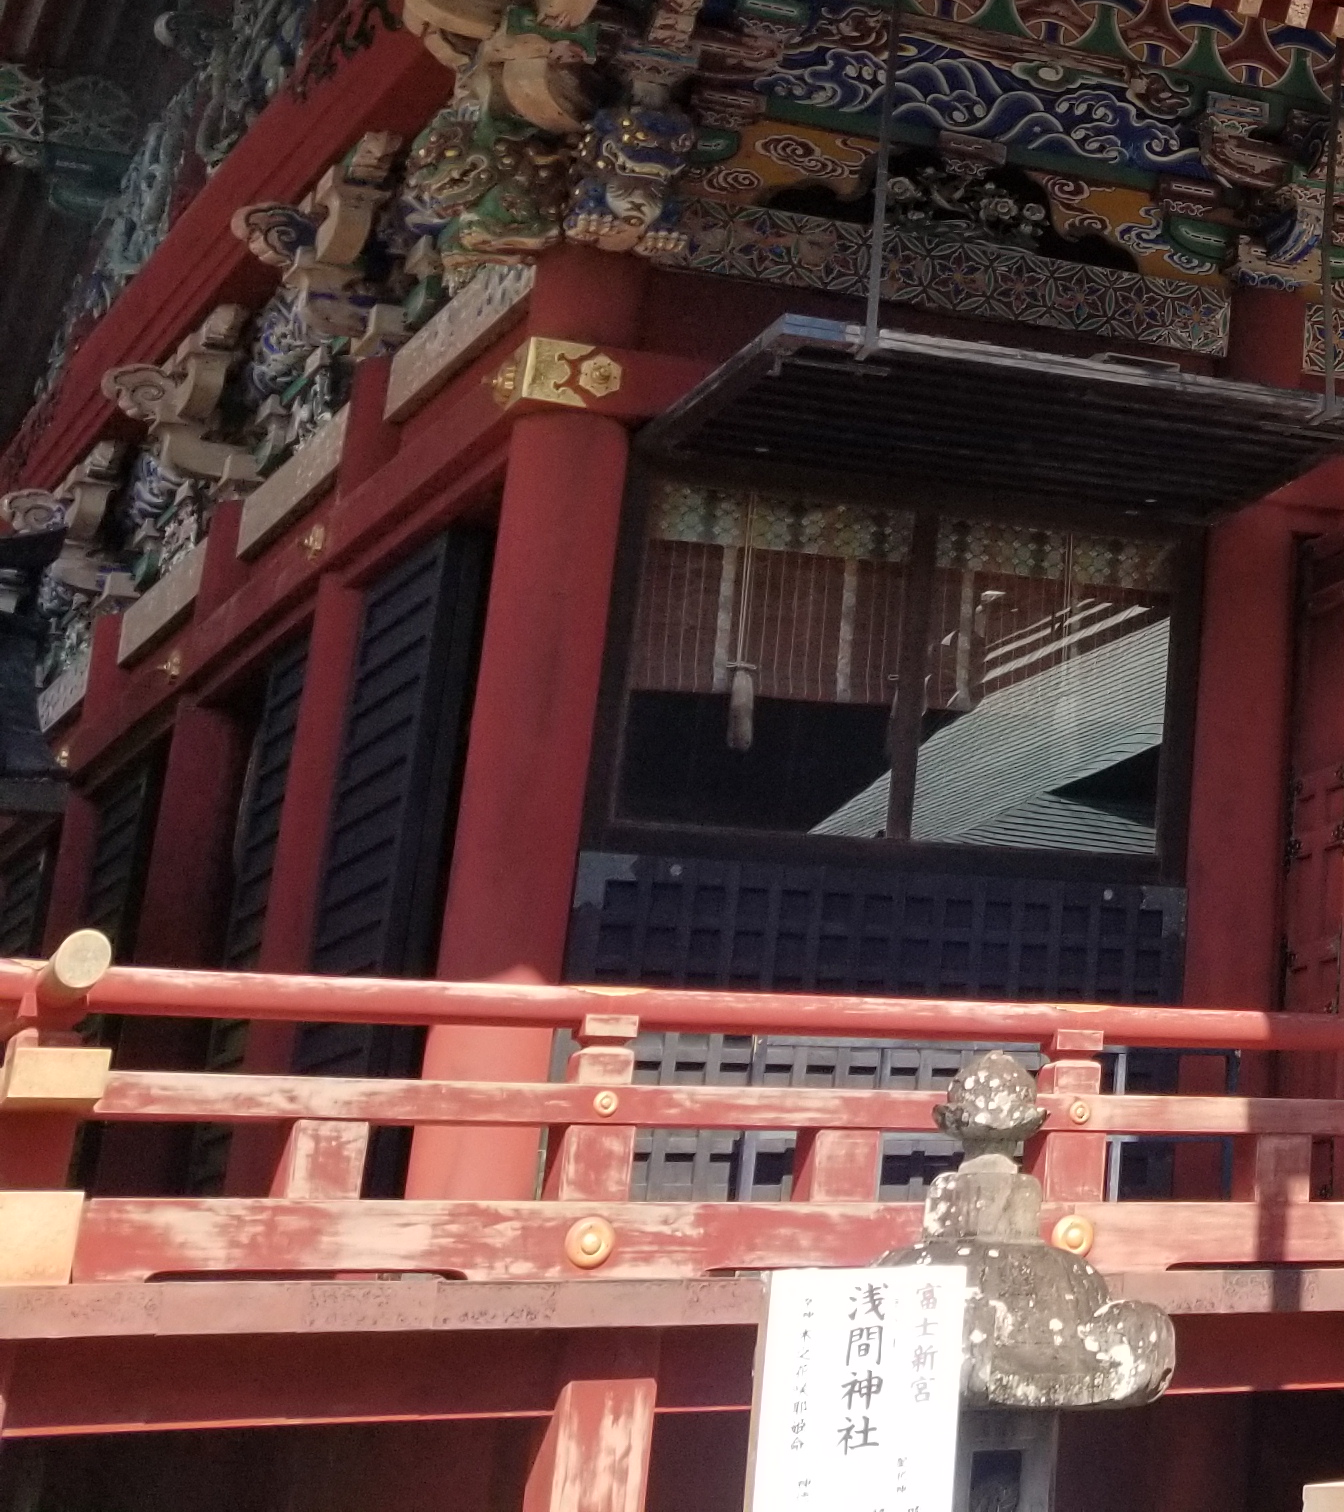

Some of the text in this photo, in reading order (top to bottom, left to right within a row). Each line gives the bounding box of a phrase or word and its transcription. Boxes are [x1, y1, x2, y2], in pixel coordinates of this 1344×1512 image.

[836, 1282, 889, 1456] 浅間神社
[910, 1282, 942, 1403] 富士新宮
